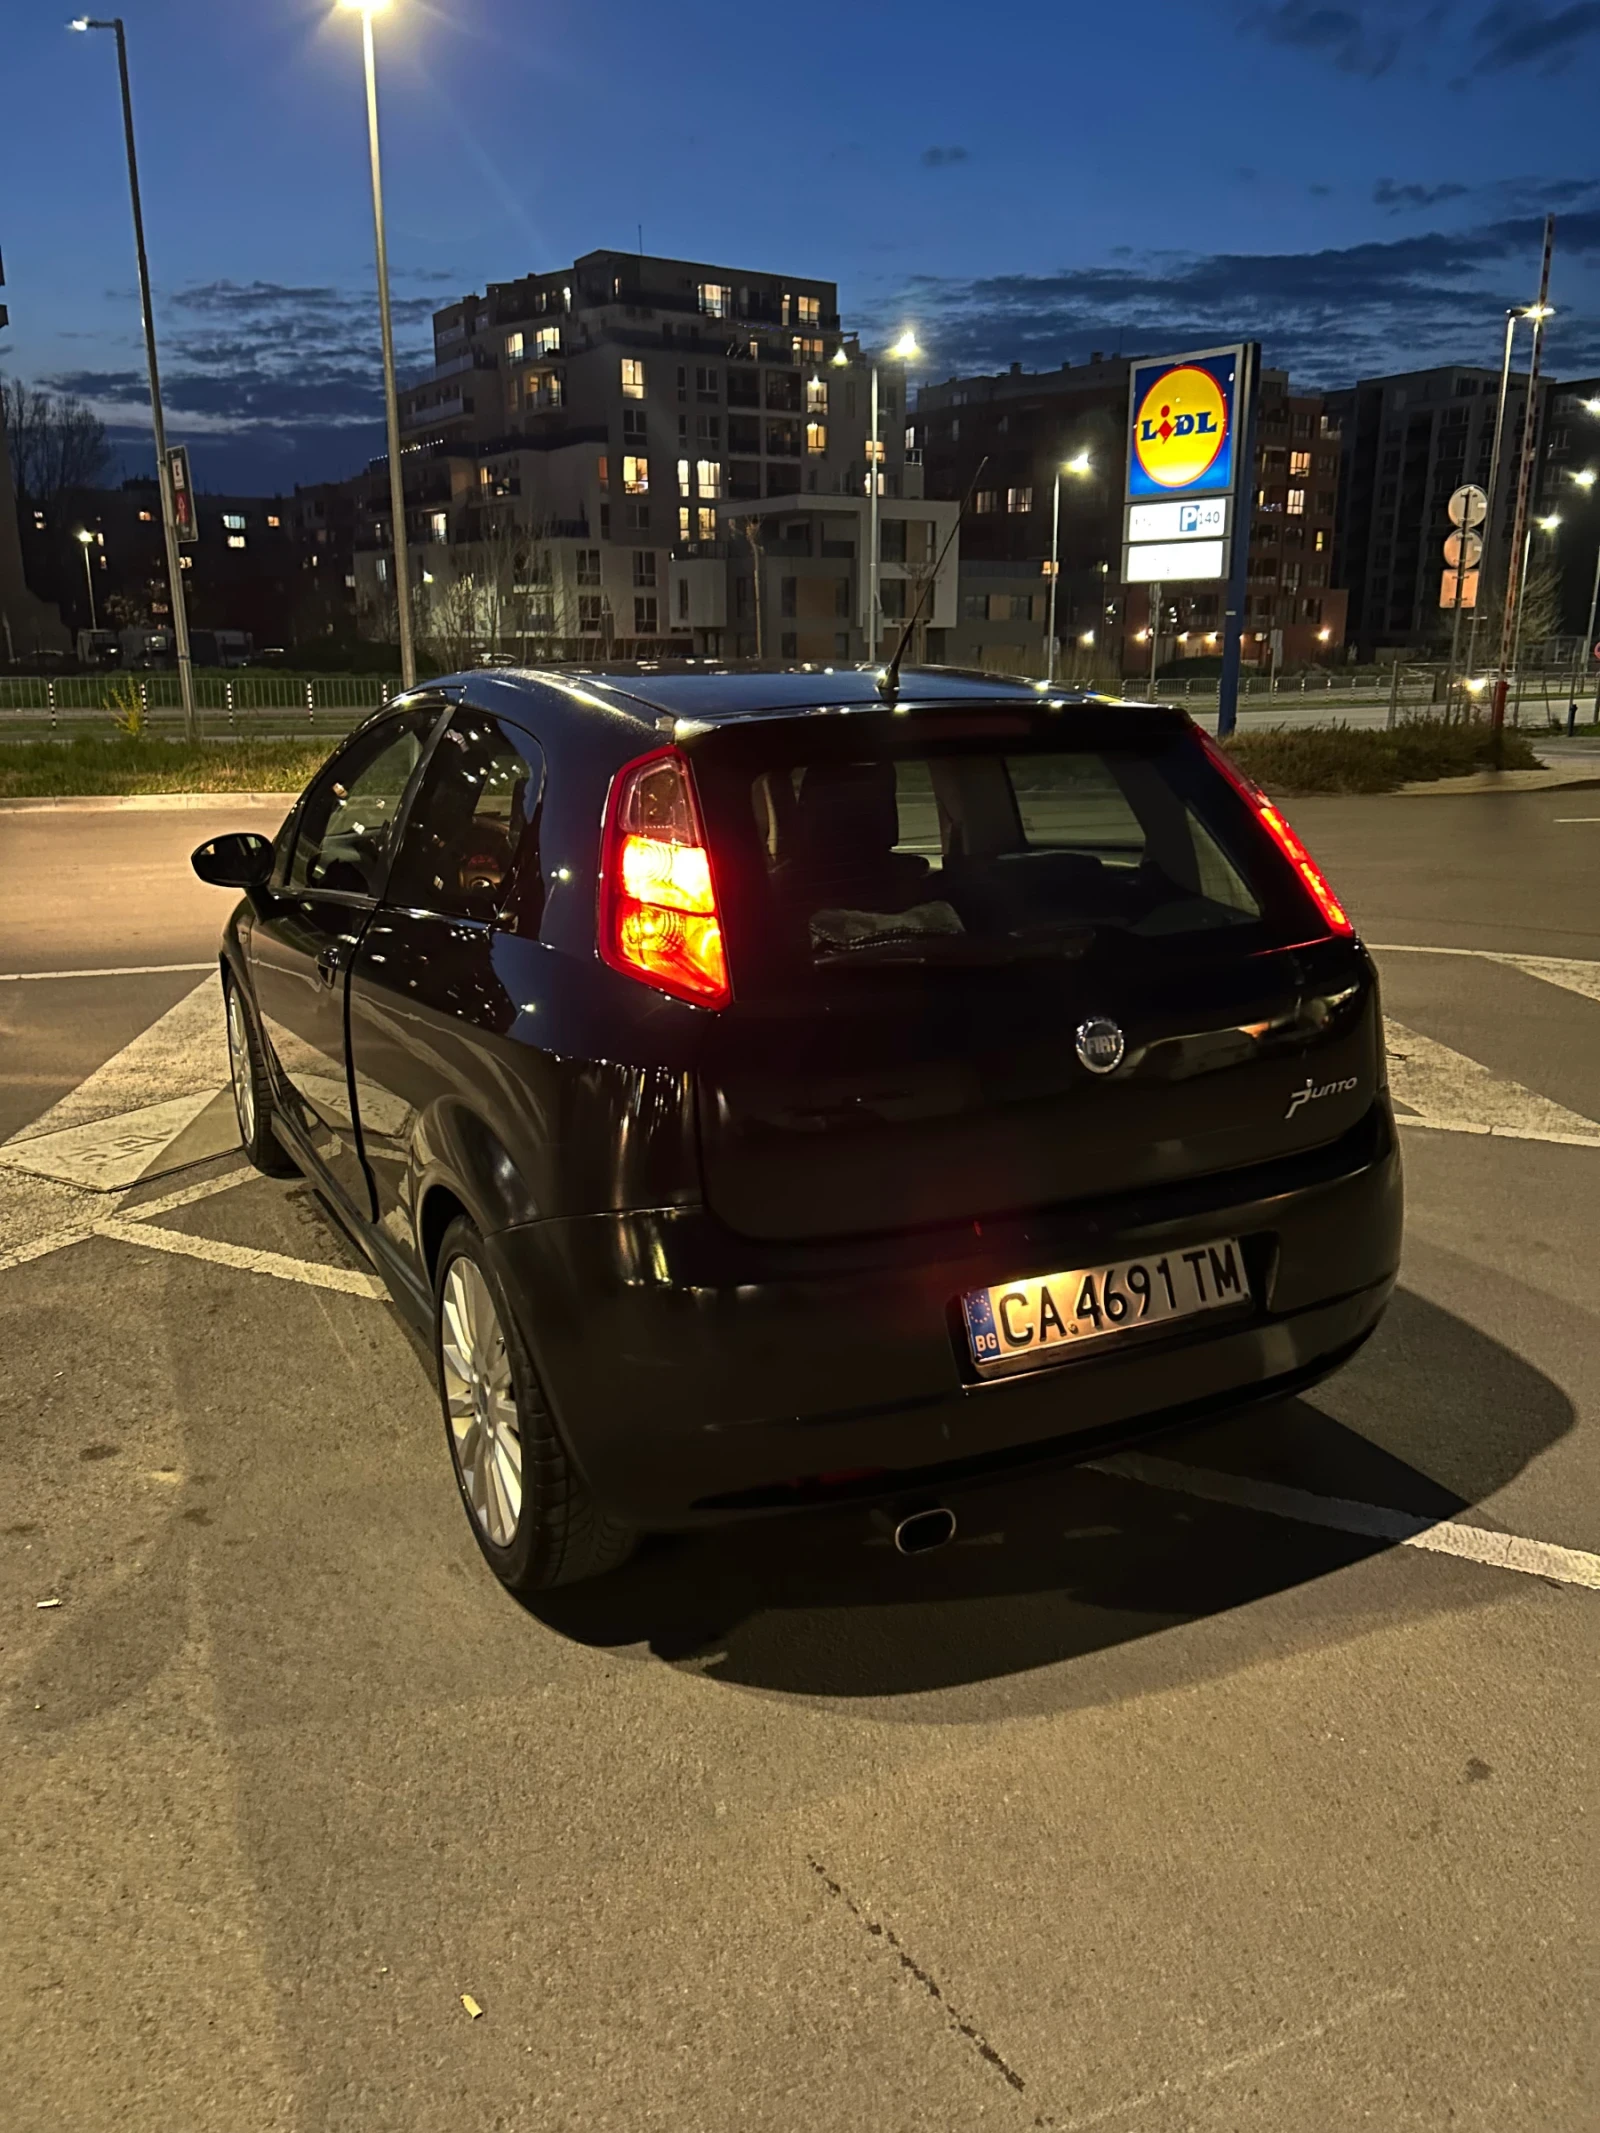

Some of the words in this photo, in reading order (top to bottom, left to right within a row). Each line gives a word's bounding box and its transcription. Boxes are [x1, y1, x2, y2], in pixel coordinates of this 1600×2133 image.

[1199, 511, 1220, 525] 140
[1085, 1035, 1117, 1055] FIAT
[999, 1286, 1067, 1347] CA
[1075, 1257, 1178, 1328] 4691
[1182, 1244, 1242, 1303] TM
[975, 1333, 997, 1352] BG
